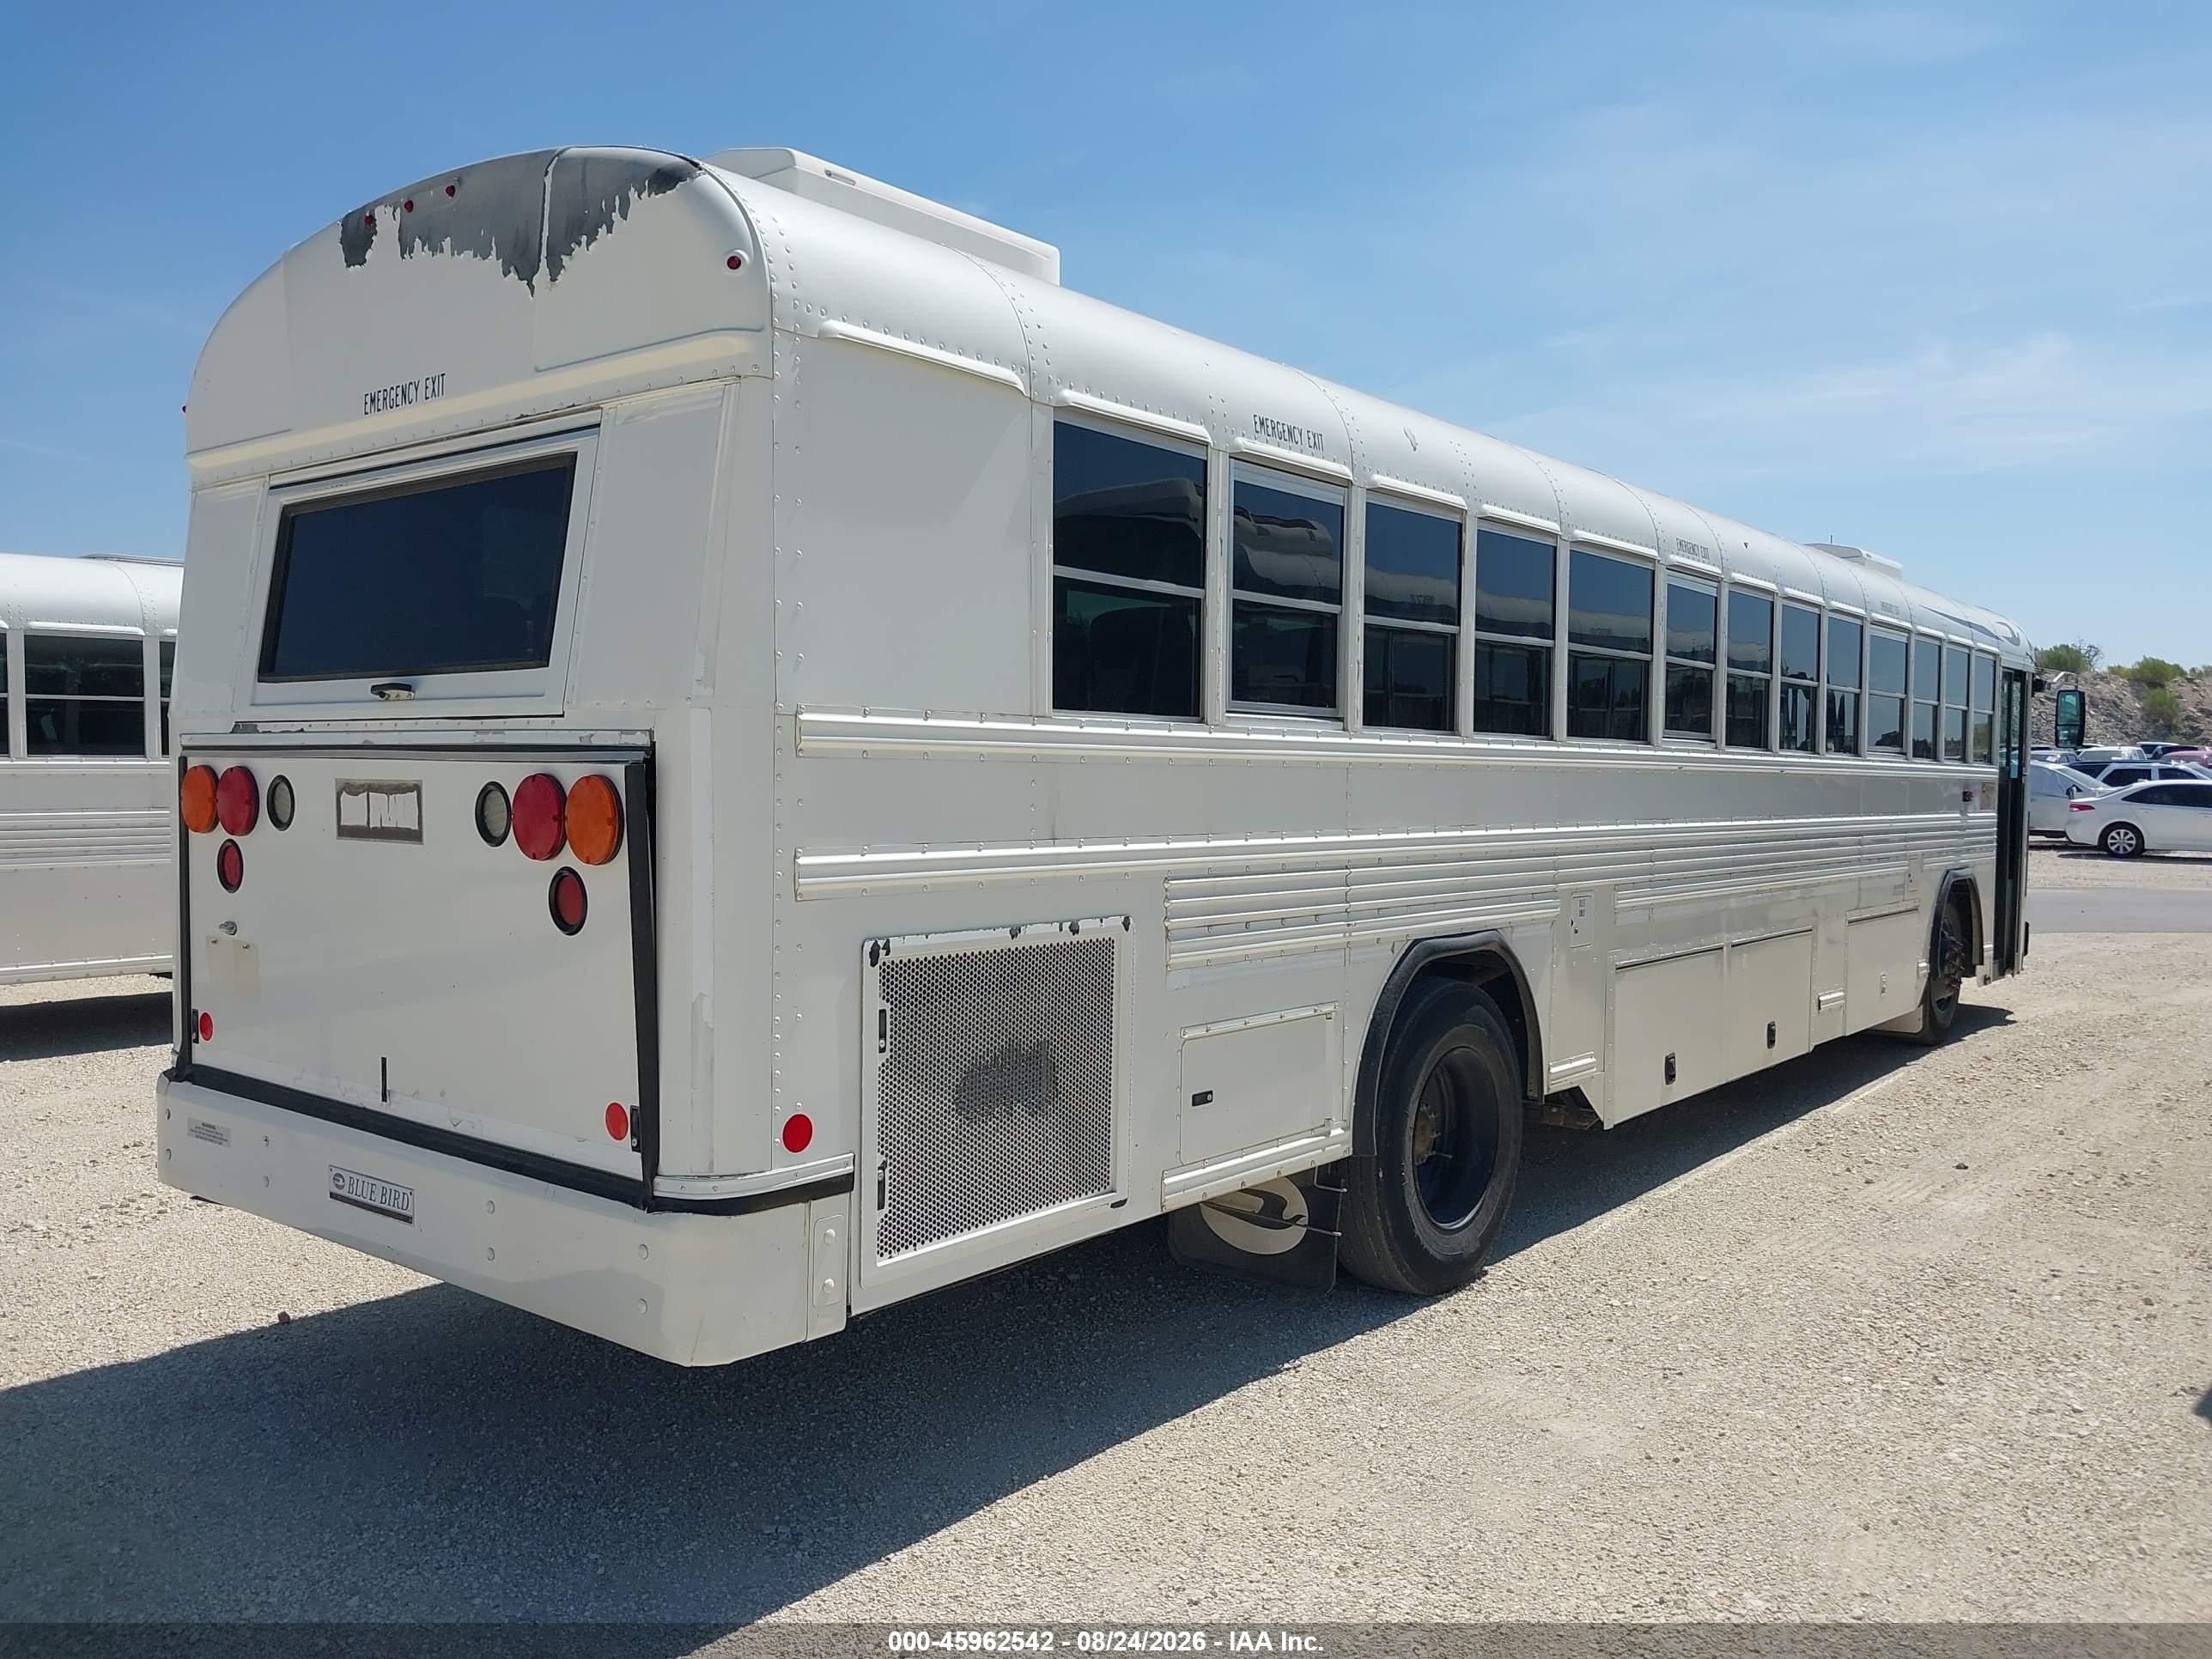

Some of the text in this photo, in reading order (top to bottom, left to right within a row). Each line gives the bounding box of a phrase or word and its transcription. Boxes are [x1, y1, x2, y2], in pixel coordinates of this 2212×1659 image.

[364, 373, 446, 416] EMERGENCY EXIT
[1253, 414, 1324, 452] EMERGENCY EXIT
[347, 1175, 410, 1211] BLUE BIRD
